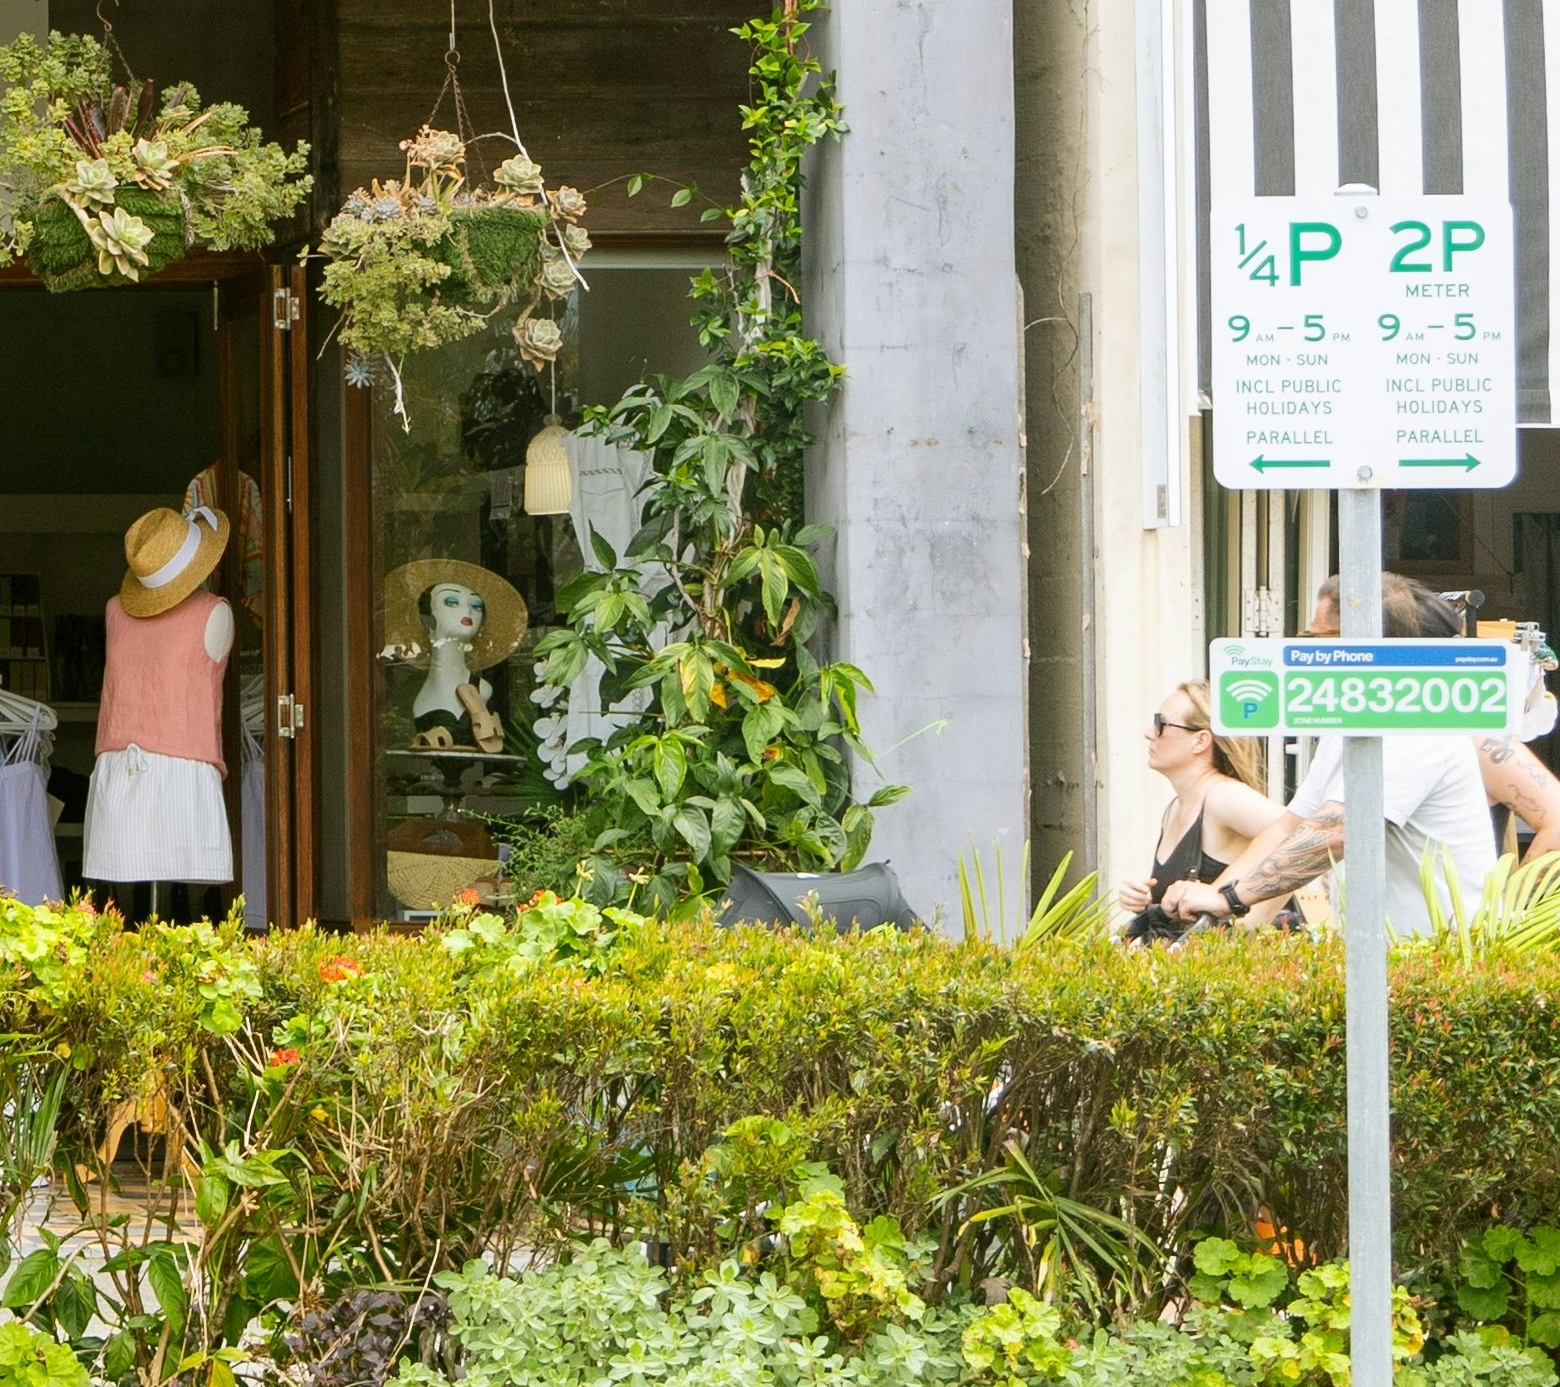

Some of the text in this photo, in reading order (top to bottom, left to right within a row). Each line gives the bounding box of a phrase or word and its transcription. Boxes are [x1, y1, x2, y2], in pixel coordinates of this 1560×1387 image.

[1389, 220, 1486, 273] 2P
[1405, 283, 1471, 298] METER
[1246, 353, 1281, 366] MON
[1296, 353, 1329, 366] SUN
[1396, 352, 1431, 365] MON
[1447, 351, 1479, 365] SUN
[1236, 378, 1342, 394] INCL PUBLIC
[1386, 377, 1492, 393] INCL PUBLIC
[1246, 400, 1333, 415] HOLIDAYS
[1396, 399, 1483, 414] HOLIDAYS
[1246, 430, 1334, 445] PARALLEL
[1396, 429, 1485, 444] PARALLEL
[1231, 656, 1274, 668] PayStay
[1290, 649, 1374, 665] Pay by Phone
[1286, 676, 1507, 714] 24832002
